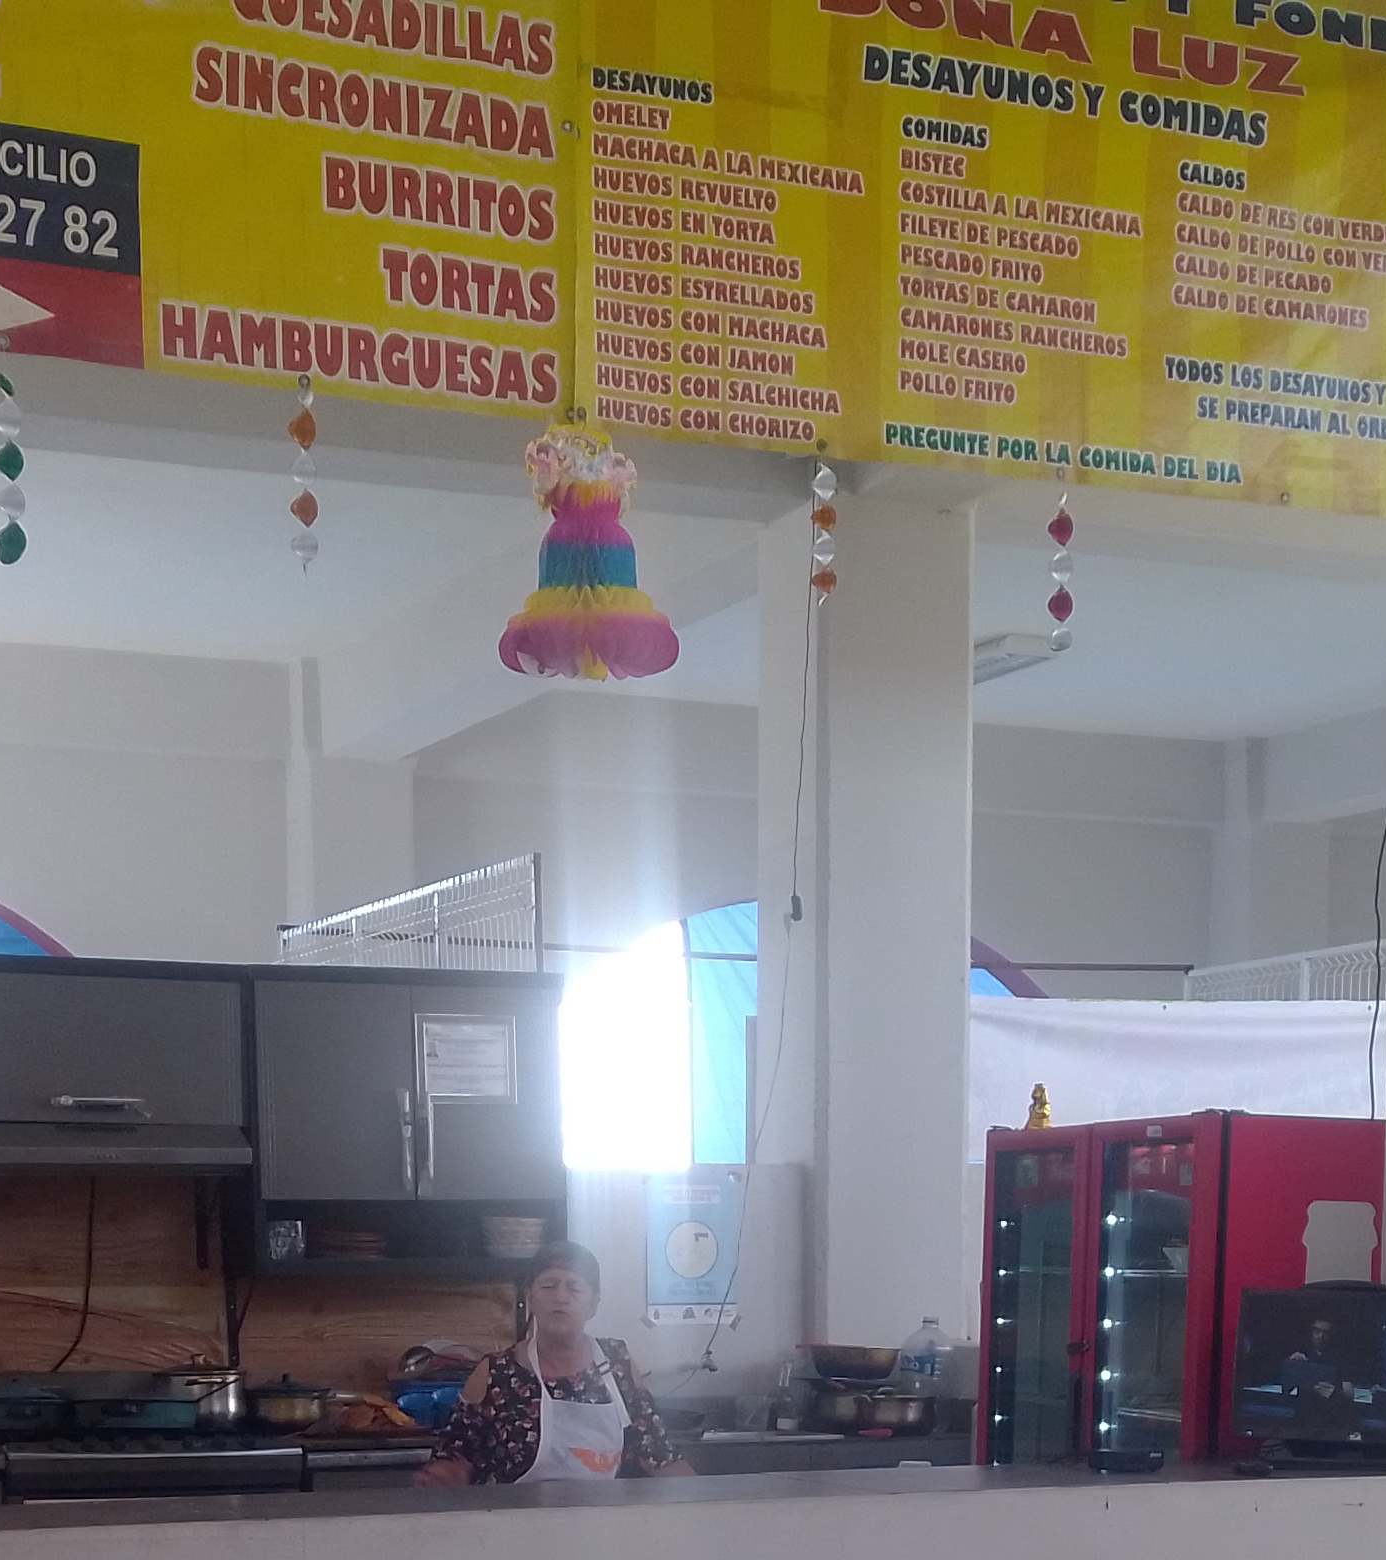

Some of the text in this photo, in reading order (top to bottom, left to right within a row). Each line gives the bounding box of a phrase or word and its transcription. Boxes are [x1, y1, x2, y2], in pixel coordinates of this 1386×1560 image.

[592, 66, 713, 104] DESAYUNOS
[1132, 26, 1305, 97] LUZ
[194, 46, 554, 158] SINCRONIZADA
[592, 100, 670, 131] OMELET
[863, 45, 1267, 146] DESAYUNOS Y COMIDAS
[902, 116, 988, 149] COMIDAS
[593, 133, 863, 194] MACHACA A LA MEXICANA
[900, 148, 965, 178] BISTEC
[1179, 161, 1246, 191] CALDOS
[325, 156, 554, 241] BURRITOS
[593, 166, 777, 212] HUEVOS REVUELTO
[900, 180, 1141, 237] COSTILLA A LA MEXICANA
[63, 204, 120, 259] 82
[593, 199, 775, 245] HUEVOS EN TORTA
[900, 212, 1079, 258] FILETE DE PESCADO
[1178, 192, 1234, 220] CALDO
[1240, 202, 1262, 225] DE
[1267, 207, 1297, 231] RES
[1303, 214, 1335, 238] CON
[594, 232, 800, 281] HUEVOS RANCHEROS
[901, 243, 1042, 284] PESCADO FRITO
[1176, 223, 1231, 251] CALDO
[1237, 233, 1259, 256] DE
[1265, 238, 1316, 264] POLLO
[1322, 247, 1357, 269] CON
[382, 248, 556, 323] TORTAS
[594, 266, 814, 315] HUEVOS ESTRELLADOS
[900, 275, 1096, 323] TORTAS DE CAMARON
[161, 303, 557, 404] HAMBURGUESAS
[900, 307, 1127, 357] CAMARONES RANCHEROS
[900, 338, 1026, 374] MOLE CASERO
[900, 370, 1016, 404] POLLO FRITO
[1165, 356, 1224, 385] TODOS
[1230, 364, 1263, 391] LOS
[1270, 369, 1371, 404] DESAYUNOS
[1374, 383, 1386, 406] Y
[1197, 395, 1219, 420] SE
[1225, 398, 1322, 433] PREPARAN
[1326, 412, 1351, 436] AL
[885, 423, 1242, 484] PREGUNTE POR LA COMIDA DEL DIA
